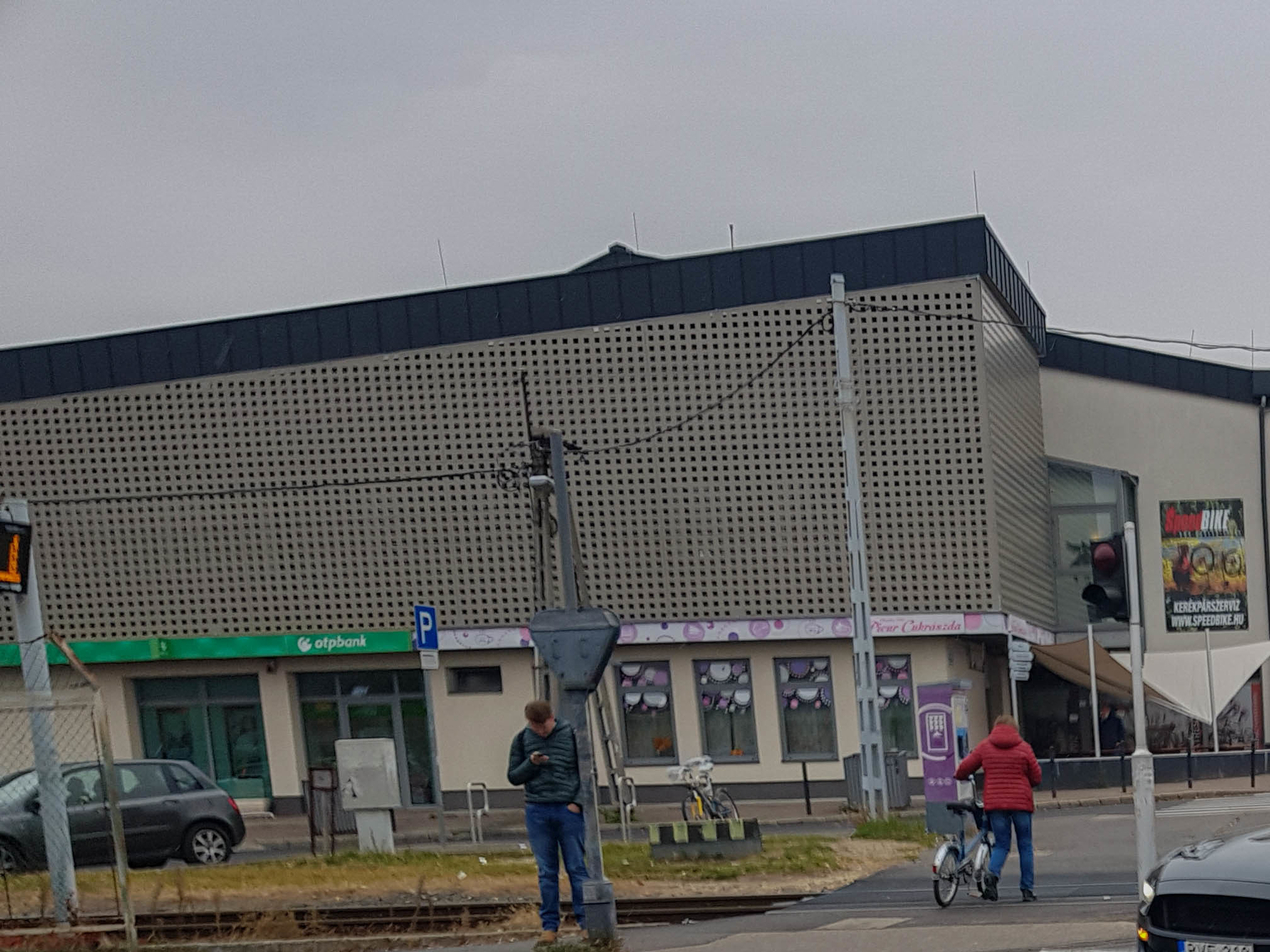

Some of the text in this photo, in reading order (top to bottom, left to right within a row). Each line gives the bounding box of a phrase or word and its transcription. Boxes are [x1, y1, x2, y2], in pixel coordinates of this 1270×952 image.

[419, 611, 433, 644] P
[1171, 614, 1244, 627] WWW.SPEEDBIKE.HU
[314, 635, 366, 651] otpbank
